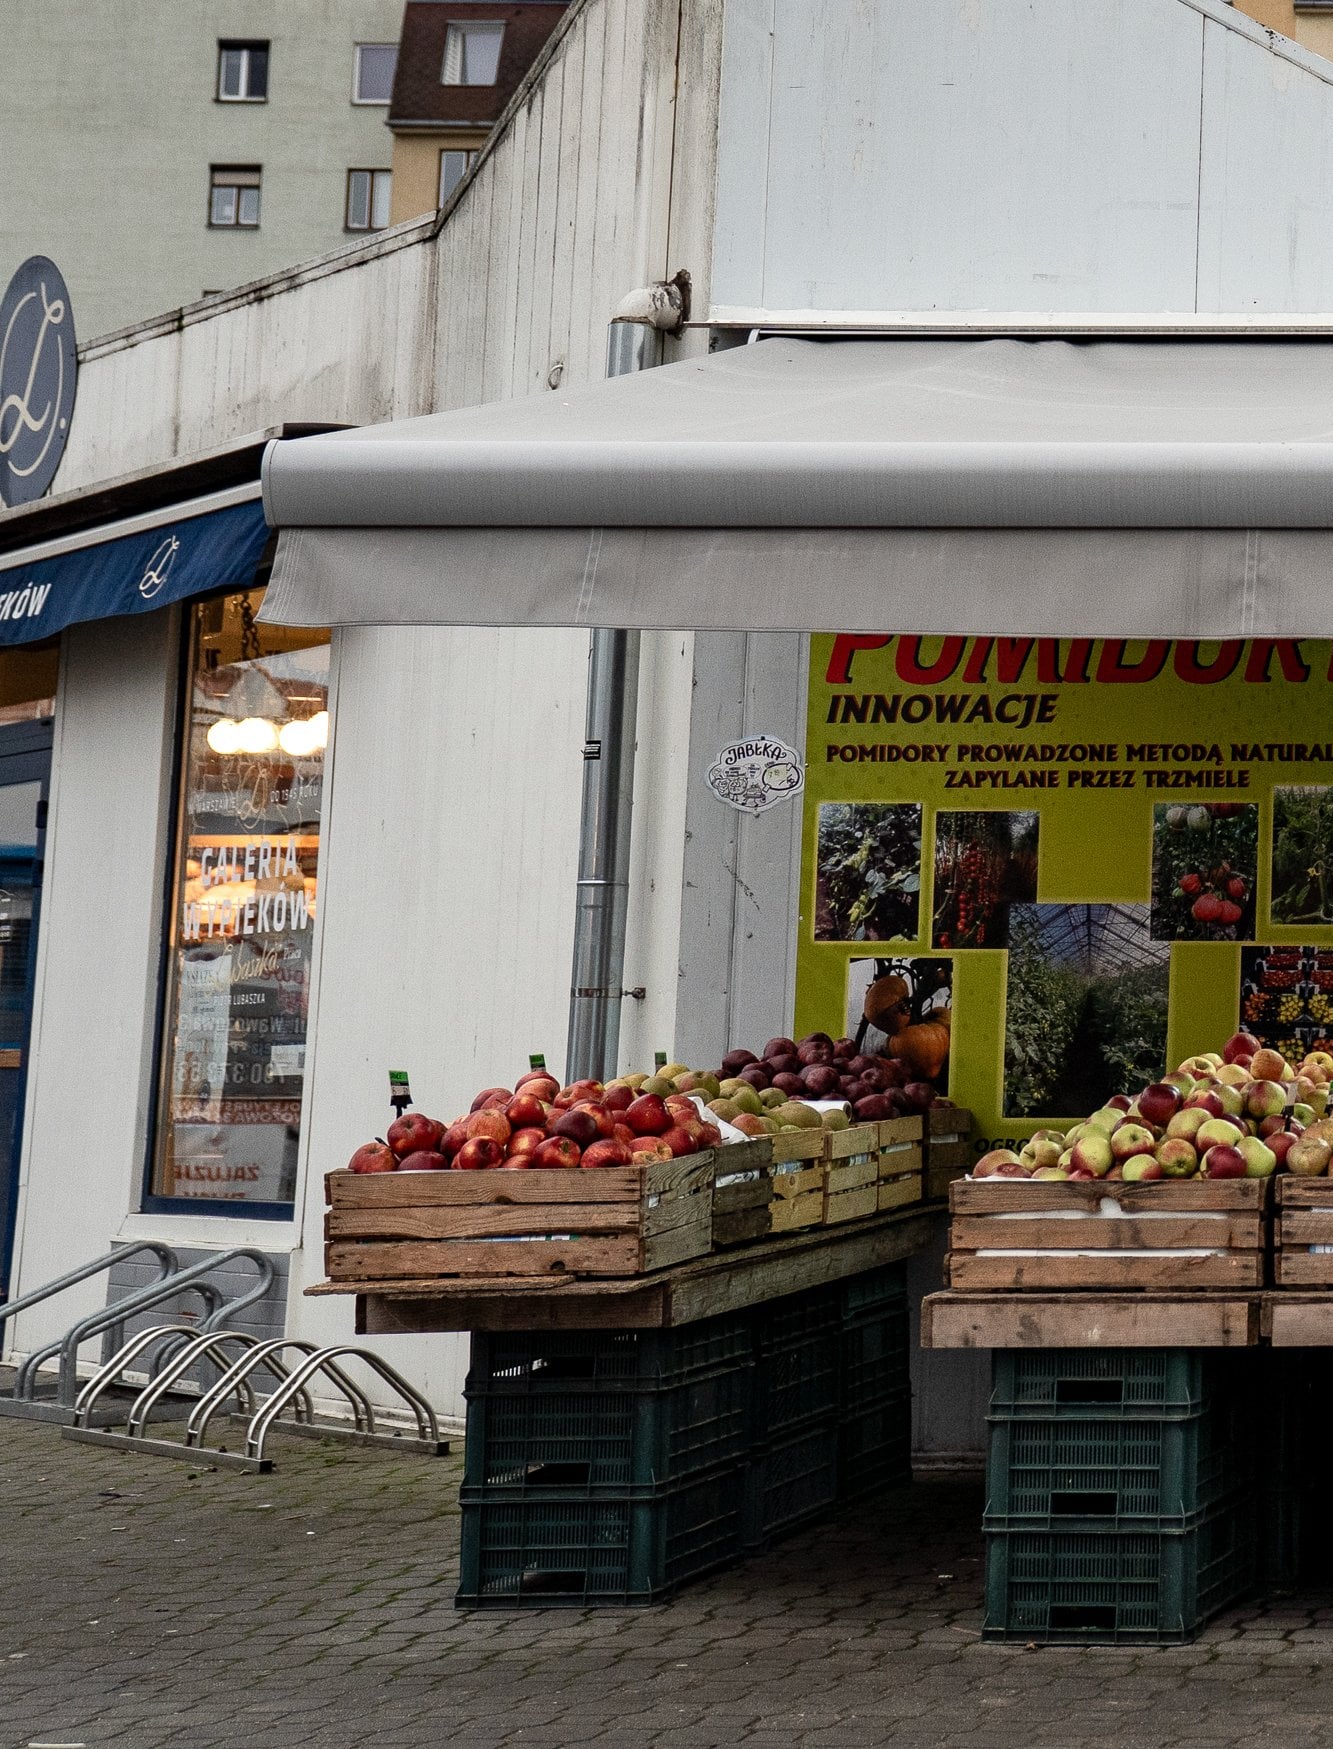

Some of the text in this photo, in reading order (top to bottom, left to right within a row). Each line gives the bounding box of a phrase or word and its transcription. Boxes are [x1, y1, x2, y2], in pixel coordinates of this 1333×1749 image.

[826, 693, 1060, 730] INNOWACJE
[826, 743, 951, 764] POMIDORY
[956, 743, 1120, 764] PROWADZONE
[1126, 743, 1223, 766] METODĄ
[943, 768, 1251, 789] ZAPYLANE PRZEZ TRZMIELE
[202, 836, 298, 887] GALERIA
[183, 881, 312, 941] WYPIEKÓW
